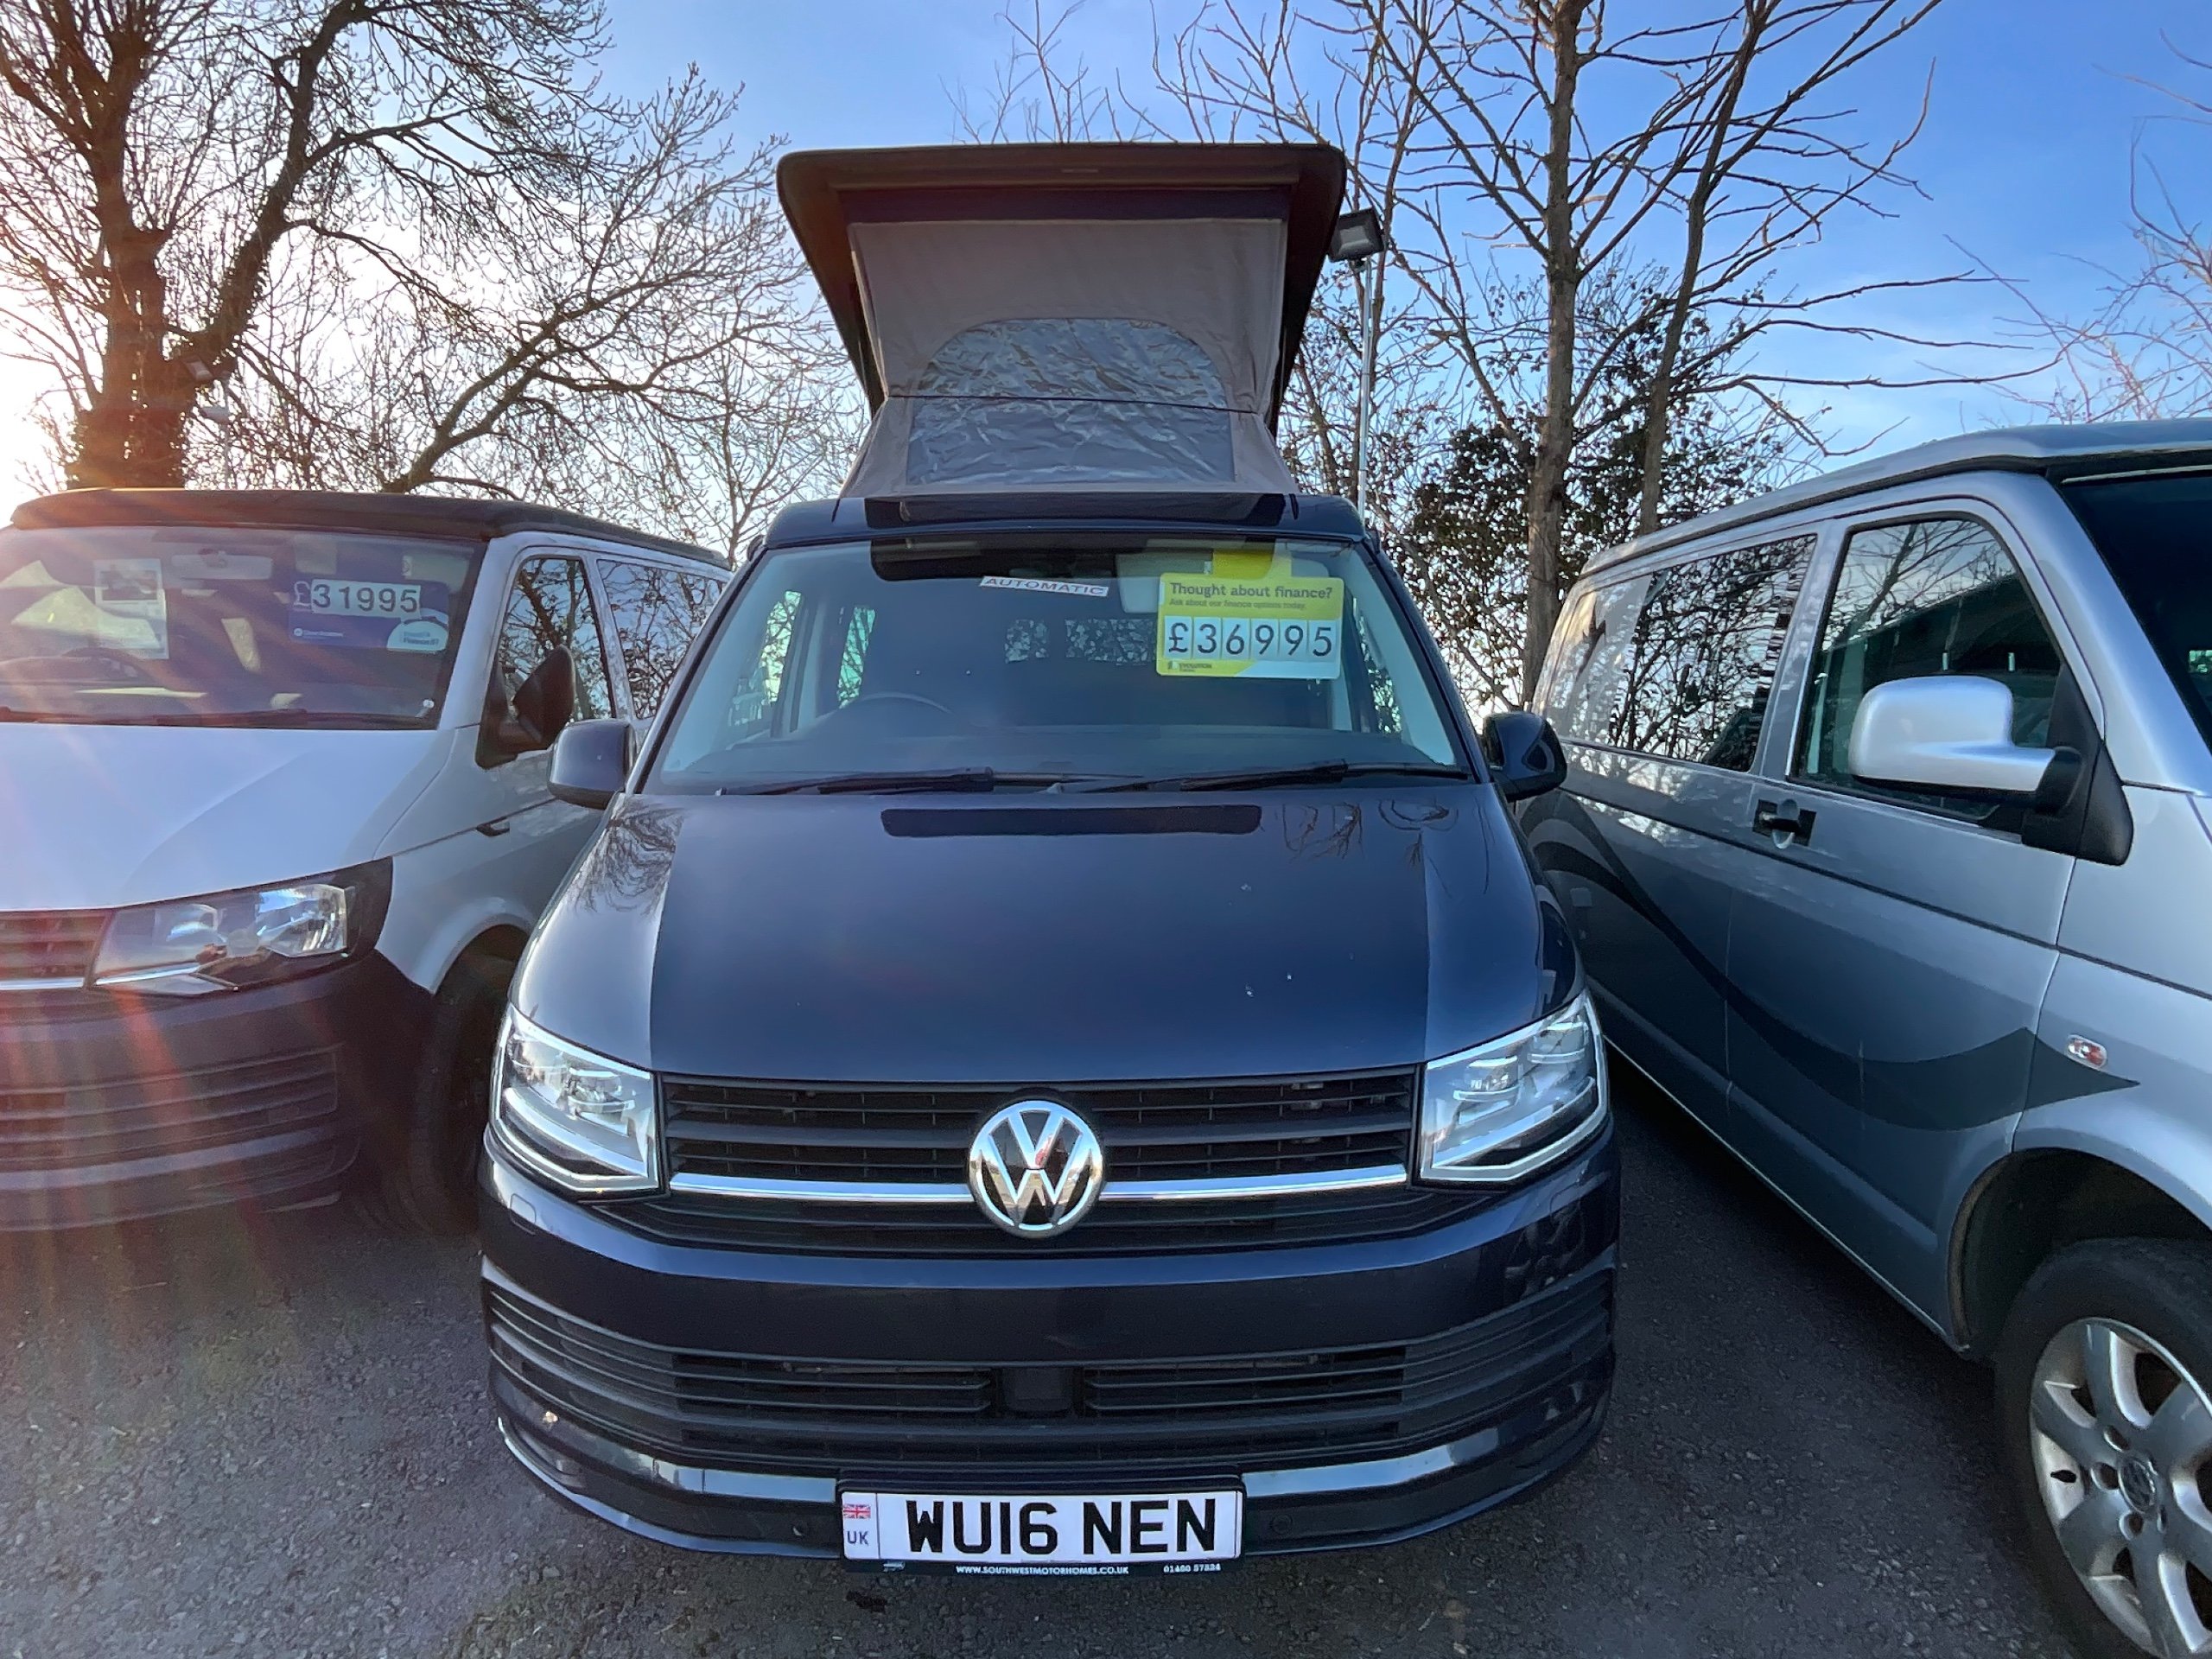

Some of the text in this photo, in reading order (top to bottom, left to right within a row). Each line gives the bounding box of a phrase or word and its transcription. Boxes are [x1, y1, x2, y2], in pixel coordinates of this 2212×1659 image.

[985, 577, 1104, 595] AUTOMATIC
[1169, 582, 1333, 599] Thought about finance?
[293, 581, 418, 613] £31995
[1224, 600, 1251, 608] finance
[1168, 622, 1332, 657] £36995
[906, 1498, 1216, 1555] WU16 NEN
[847, 1530, 869, 1545] UK
[956, 1566, 1129, 1576] WWW.SOUTHWESTMOTORHOMES.CO.UK
